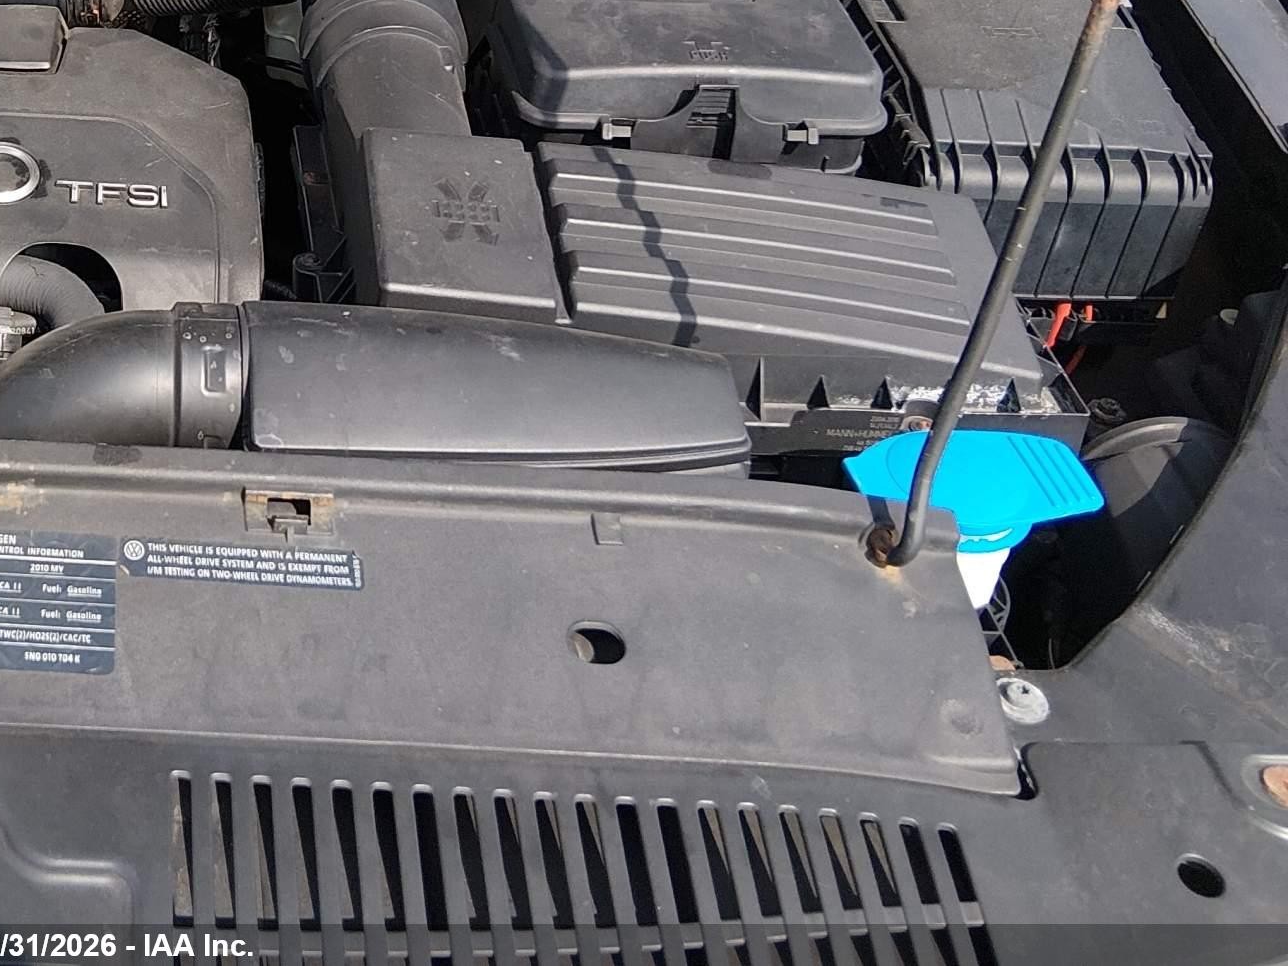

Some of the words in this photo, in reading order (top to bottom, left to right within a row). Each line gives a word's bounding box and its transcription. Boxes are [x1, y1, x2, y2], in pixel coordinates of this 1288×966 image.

[55, 179, 169, 209] TFSI
[27, 547, 84, 558] INFORMATION
[147, 542, 167, 552] THIS
[169, 544, 203, 555] VEHICLE
[205, 546, 214, 555] IS
[216, 547, 258, 558] EQUIPPED
[260, 550, 284, 560] WITH
[285, 551, 293, 560] A
[295, 552, 348, 563] PERMANENT
[30, 563, 49, 572] 2010
[147, 554, 193, 565] ALL-WHEEL
[195, 556, 219, 566] DRIVE
[222, 558, 254, 569] SYSTEM
[256, 561, 276, 570] AND
[278, 562, 286, 571] IS
[288, 563, 322, 573] EXEMPT
[323, 564, 350, 574] FROM
[147, 566, 162, 576] I/M
[164, 566, 196, 577] TESTING
[197, 568, 210, 578] ON
[212, 569, 259, 582] TWO-WHEEL
[261, 573, 285, 583] DRIVE
[286, 574, 354, 587] DYNAMOMETERS.
[42, 583, 62, 594] Fuel:
[67, 585, 102, 595] Gasoline
[41, 609, 61, 619] Fuel:
[66, 610, 102, 620] Gasoline
[42, 652, 57, 662] 010
[75, 655, 81, 664] K
